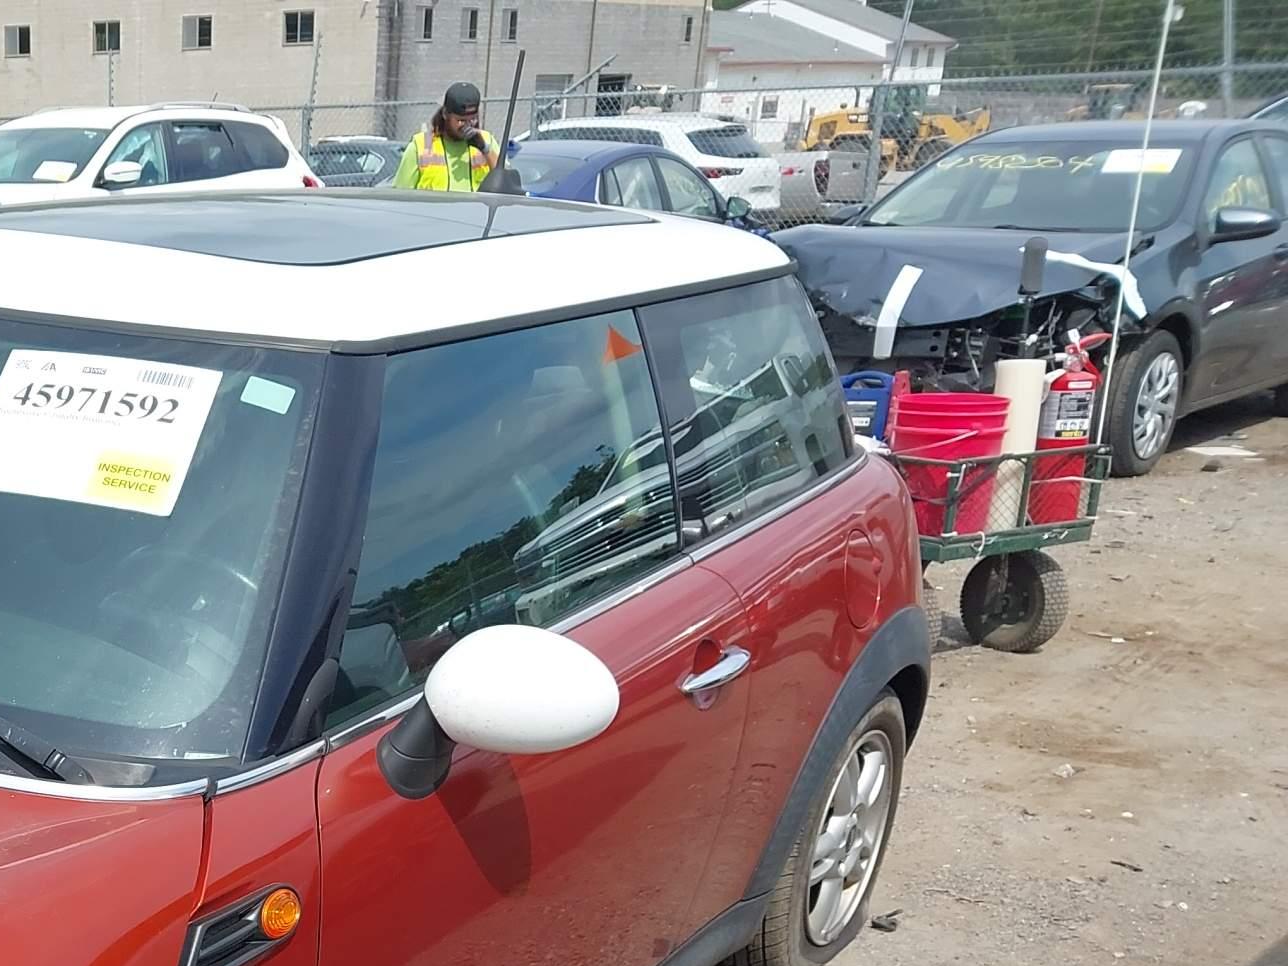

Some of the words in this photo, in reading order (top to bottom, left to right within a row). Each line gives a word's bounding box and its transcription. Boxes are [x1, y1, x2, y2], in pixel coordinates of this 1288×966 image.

[13, 382, 179, 424] 45971592
[98, 463, 171, 482] INSPECTION
[102, 477, 157, 494] SERVICE
